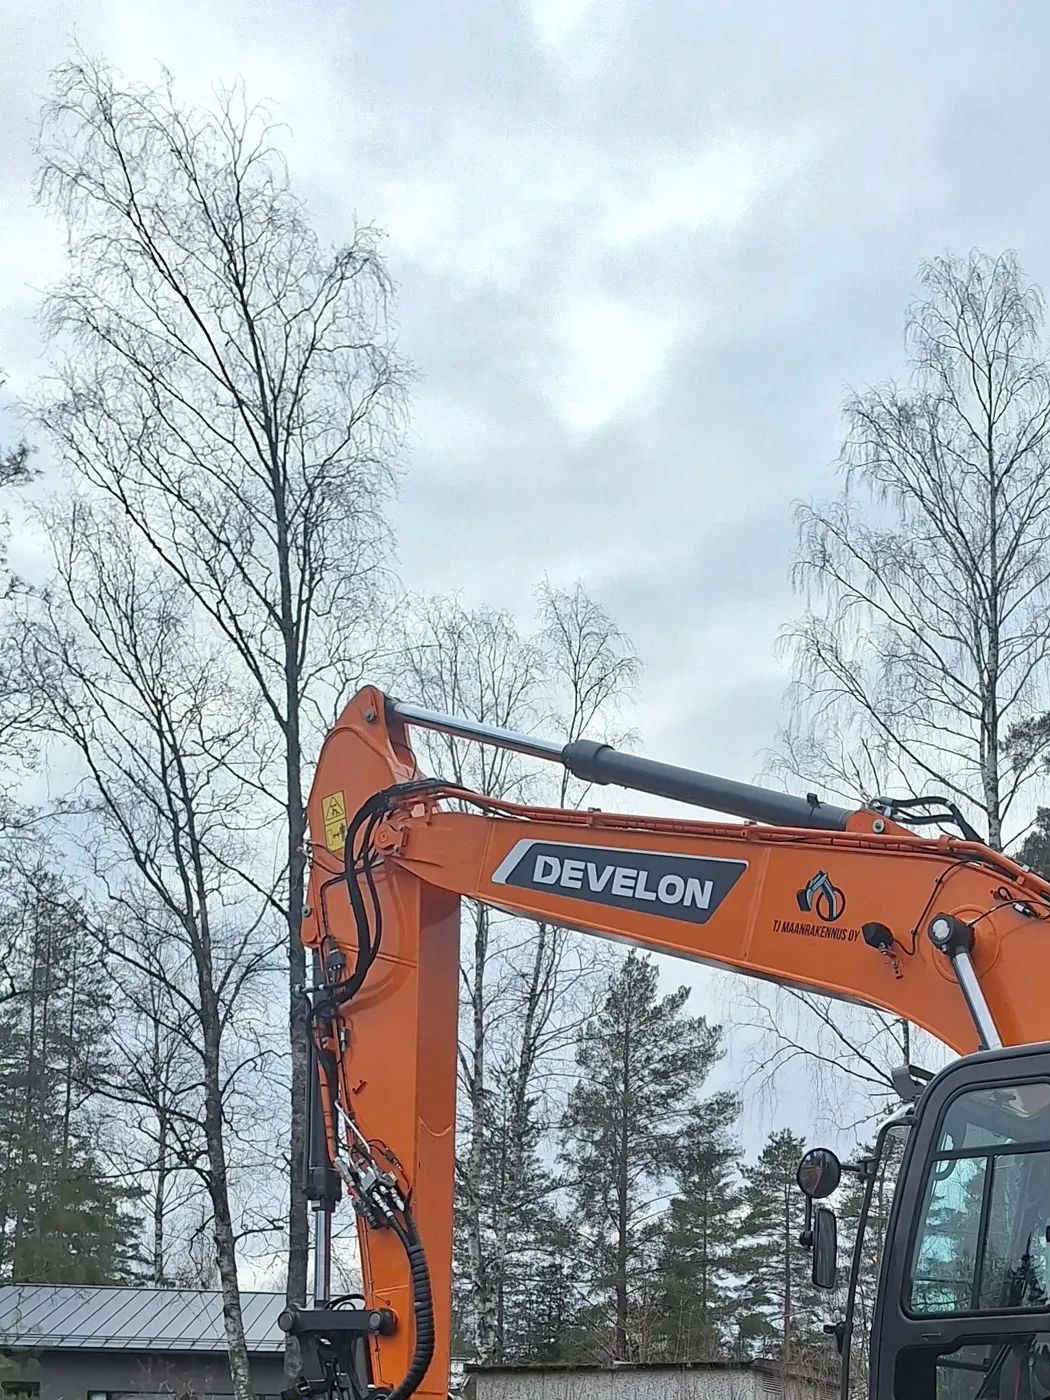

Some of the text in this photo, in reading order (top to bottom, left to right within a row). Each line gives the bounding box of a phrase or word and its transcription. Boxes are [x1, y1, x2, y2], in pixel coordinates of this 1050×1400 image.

[532, 854, 714, 910] DEVELON
[772, 919, 860, 942] TJ MAANRAKENNUS OY
